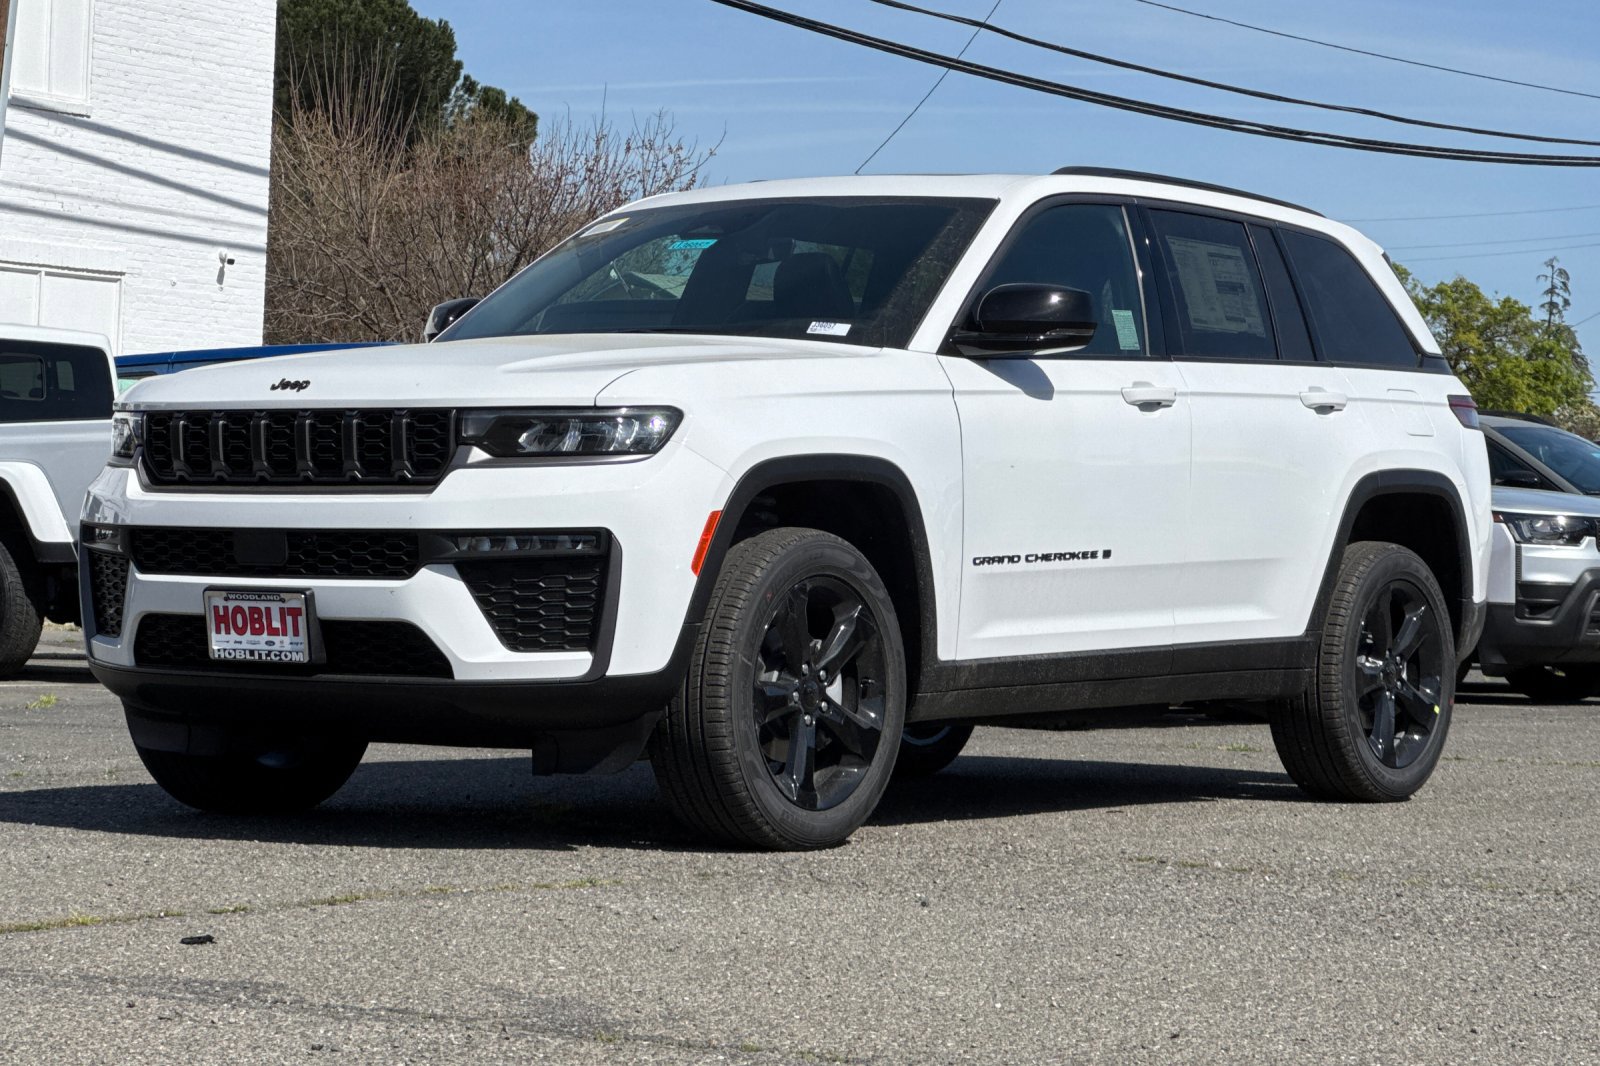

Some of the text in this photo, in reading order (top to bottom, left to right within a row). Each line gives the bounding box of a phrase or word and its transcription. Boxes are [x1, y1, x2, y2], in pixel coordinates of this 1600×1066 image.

[269, 378, 311, 392] Jeep
[972, 550, 1099, 566] GRAND CHEROKEE
[227, 593, 280, 601] WOODLAND
[213, 605, 302, 637] HOBLIT
[213, 648, 304, 662] HOBLIT.COM
